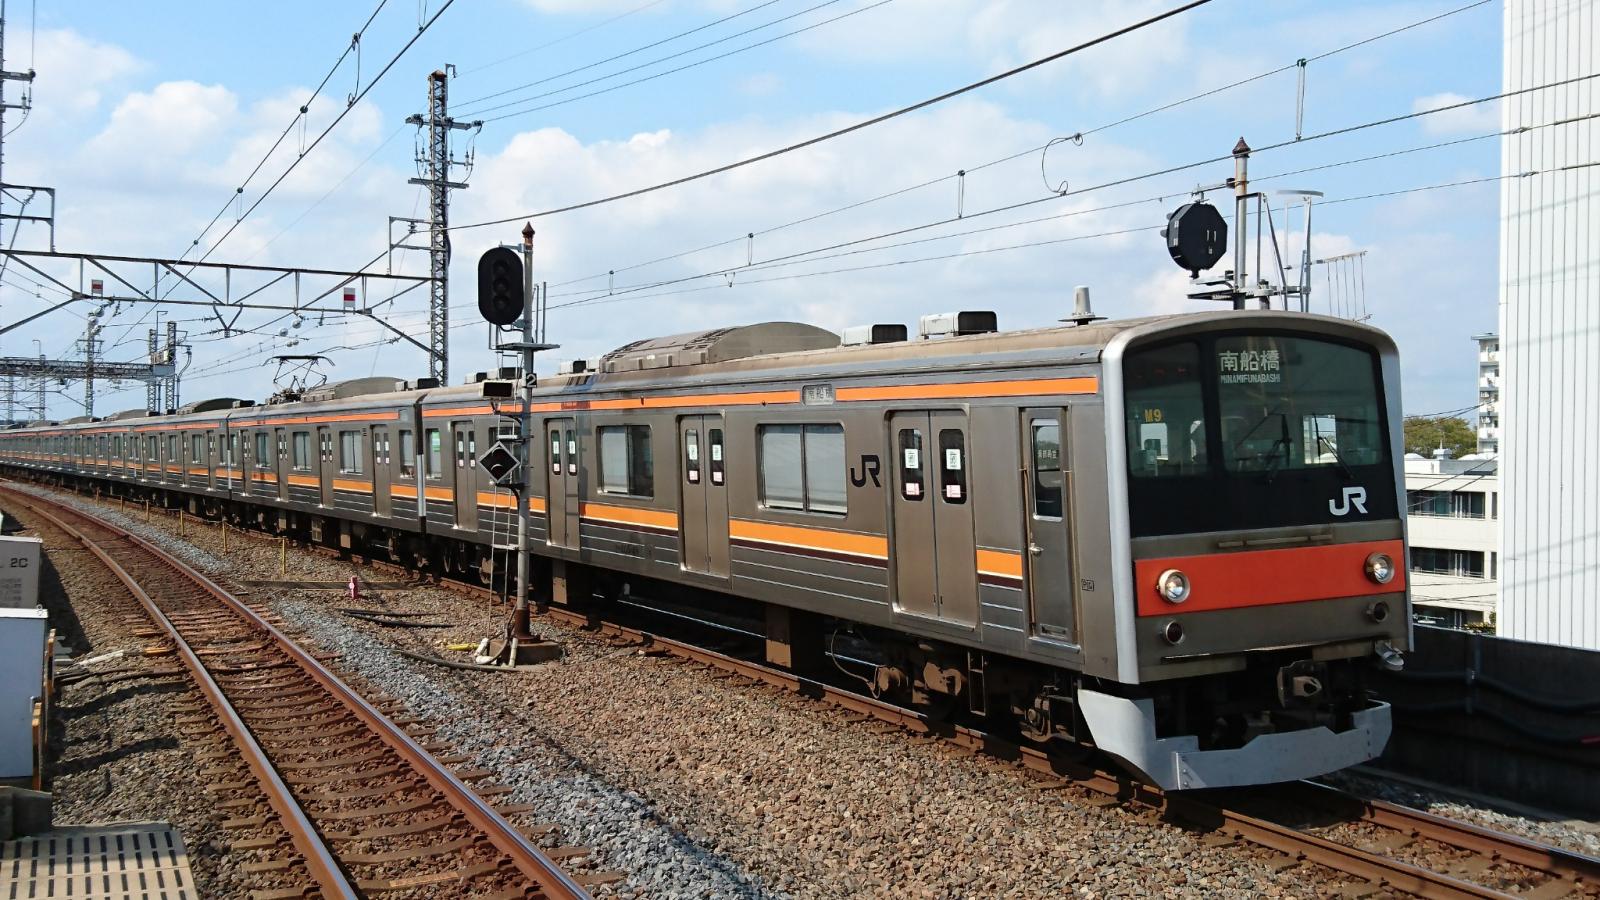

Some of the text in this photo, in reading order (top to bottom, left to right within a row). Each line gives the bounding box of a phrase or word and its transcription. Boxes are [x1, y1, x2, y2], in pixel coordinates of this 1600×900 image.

[1219, 350, 1280, 371] 南船橋
[526, 373, 537, 388] 2
[1144, 409, 1162, 422] M9
[850, 454, 881, 488] JR
[1329, 486, 1368, 515] JR
[10, 557, 28, 568] 2C
